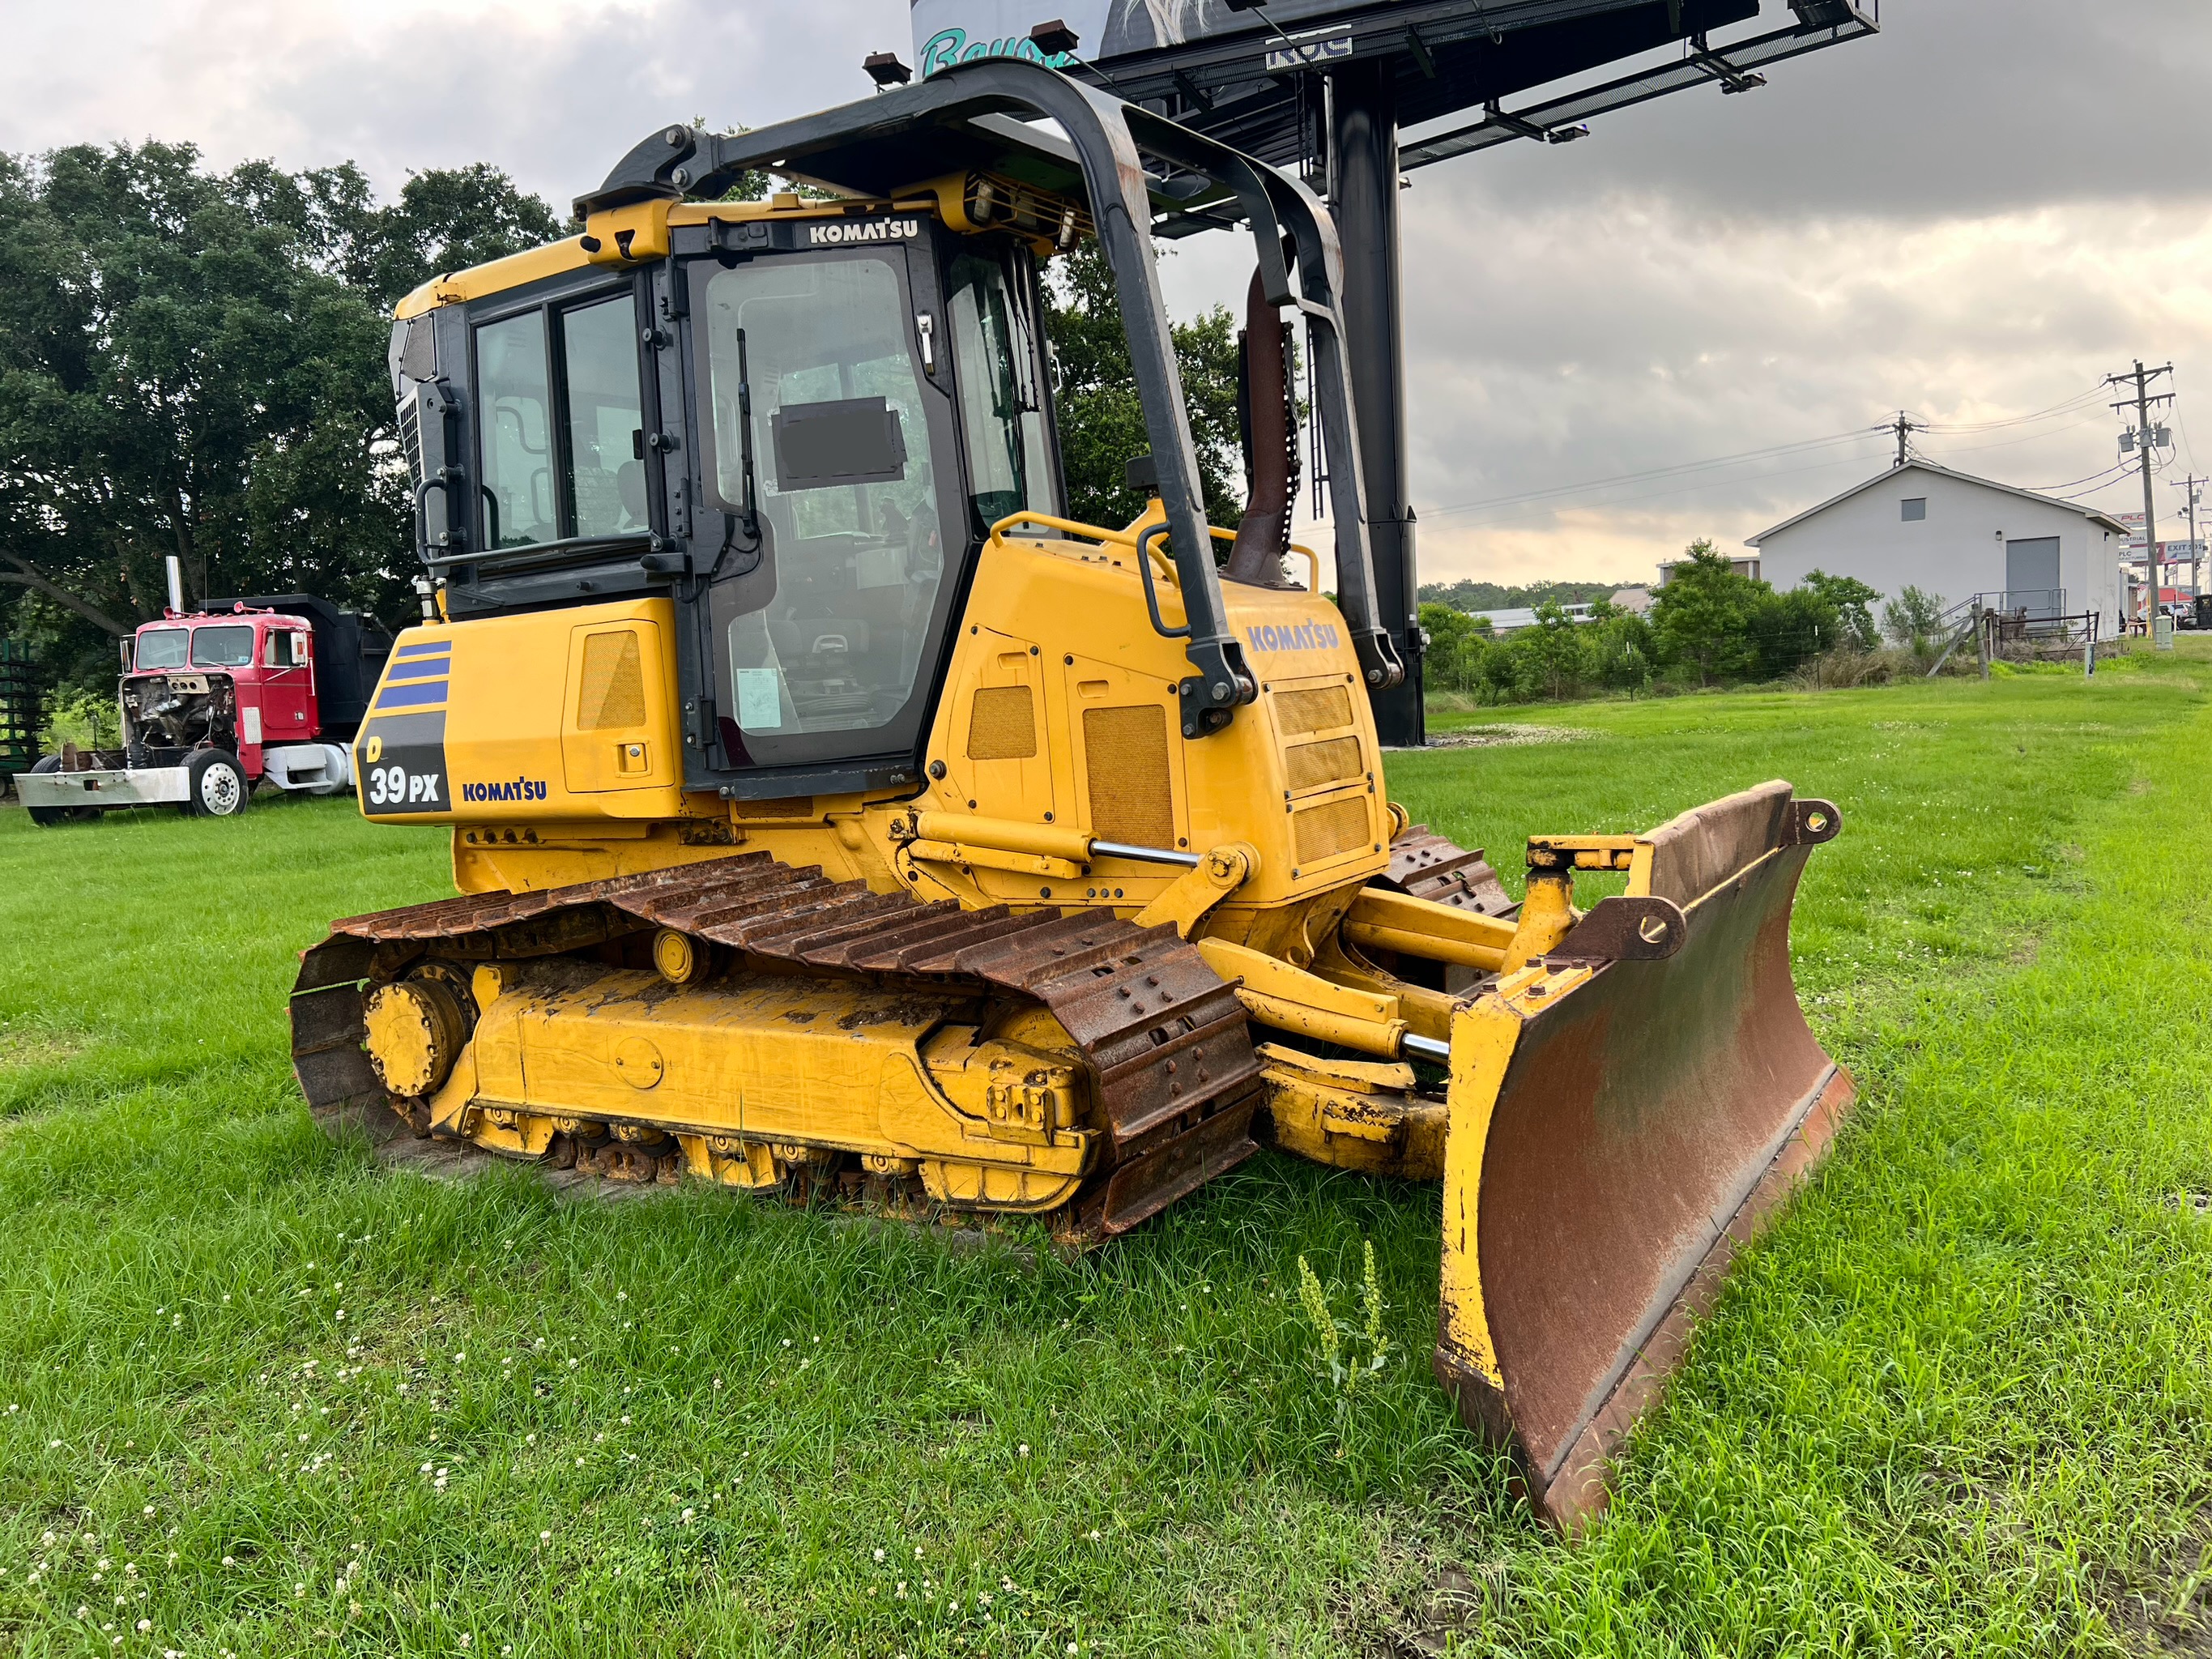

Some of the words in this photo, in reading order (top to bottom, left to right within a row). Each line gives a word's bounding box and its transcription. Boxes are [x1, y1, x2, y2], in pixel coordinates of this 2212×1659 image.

[810, 217, 918, 244] KOMATSU
[2167, 544, 2187, 552] EXIT
[1246, 618, 1339, 652] KOMATSU
[366, 736, 382, 763] D
[462, 775, 548, 802] KOMATSU
